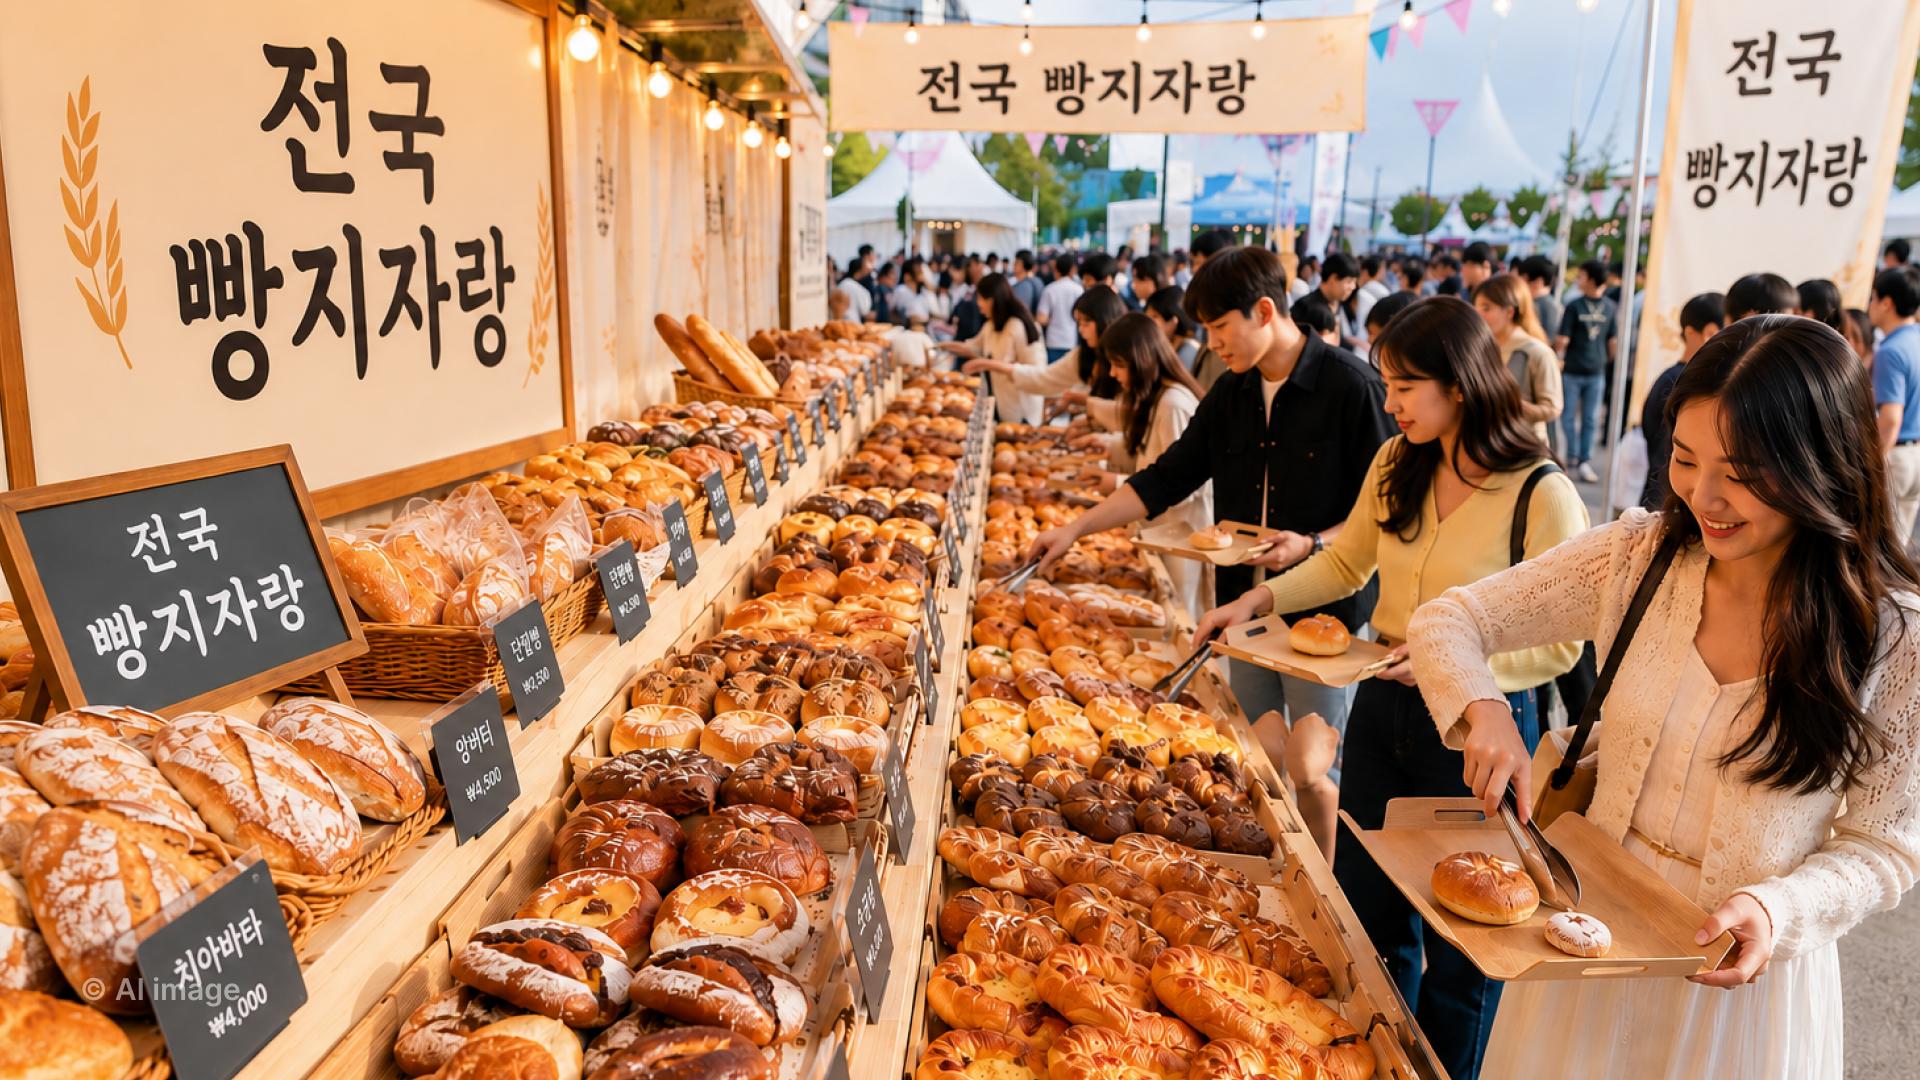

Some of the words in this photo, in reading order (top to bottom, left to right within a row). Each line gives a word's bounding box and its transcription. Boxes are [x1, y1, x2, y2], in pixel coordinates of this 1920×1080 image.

[917, 60, 1017, 114] 전국
[1044, 59, 1256, 115] 빵지자랑
[1726, 30, 1842, 96] 전국
[260, 37, 445, 204] 전국
[1687, 136, 1867, 208] 빵지자랑
[169, 220, 515, 401] 빵지자랑
[126, 507, 218, 573] 전국
[86, 564, 305, 680] 빵지자랑
[456, 719, 494, 764] 앙버터
[465, 766, 502, 802] ₩4,500
[173, 908, 262, 989] 치아바타
[207, 983, 268, 1038] ₩4,000
